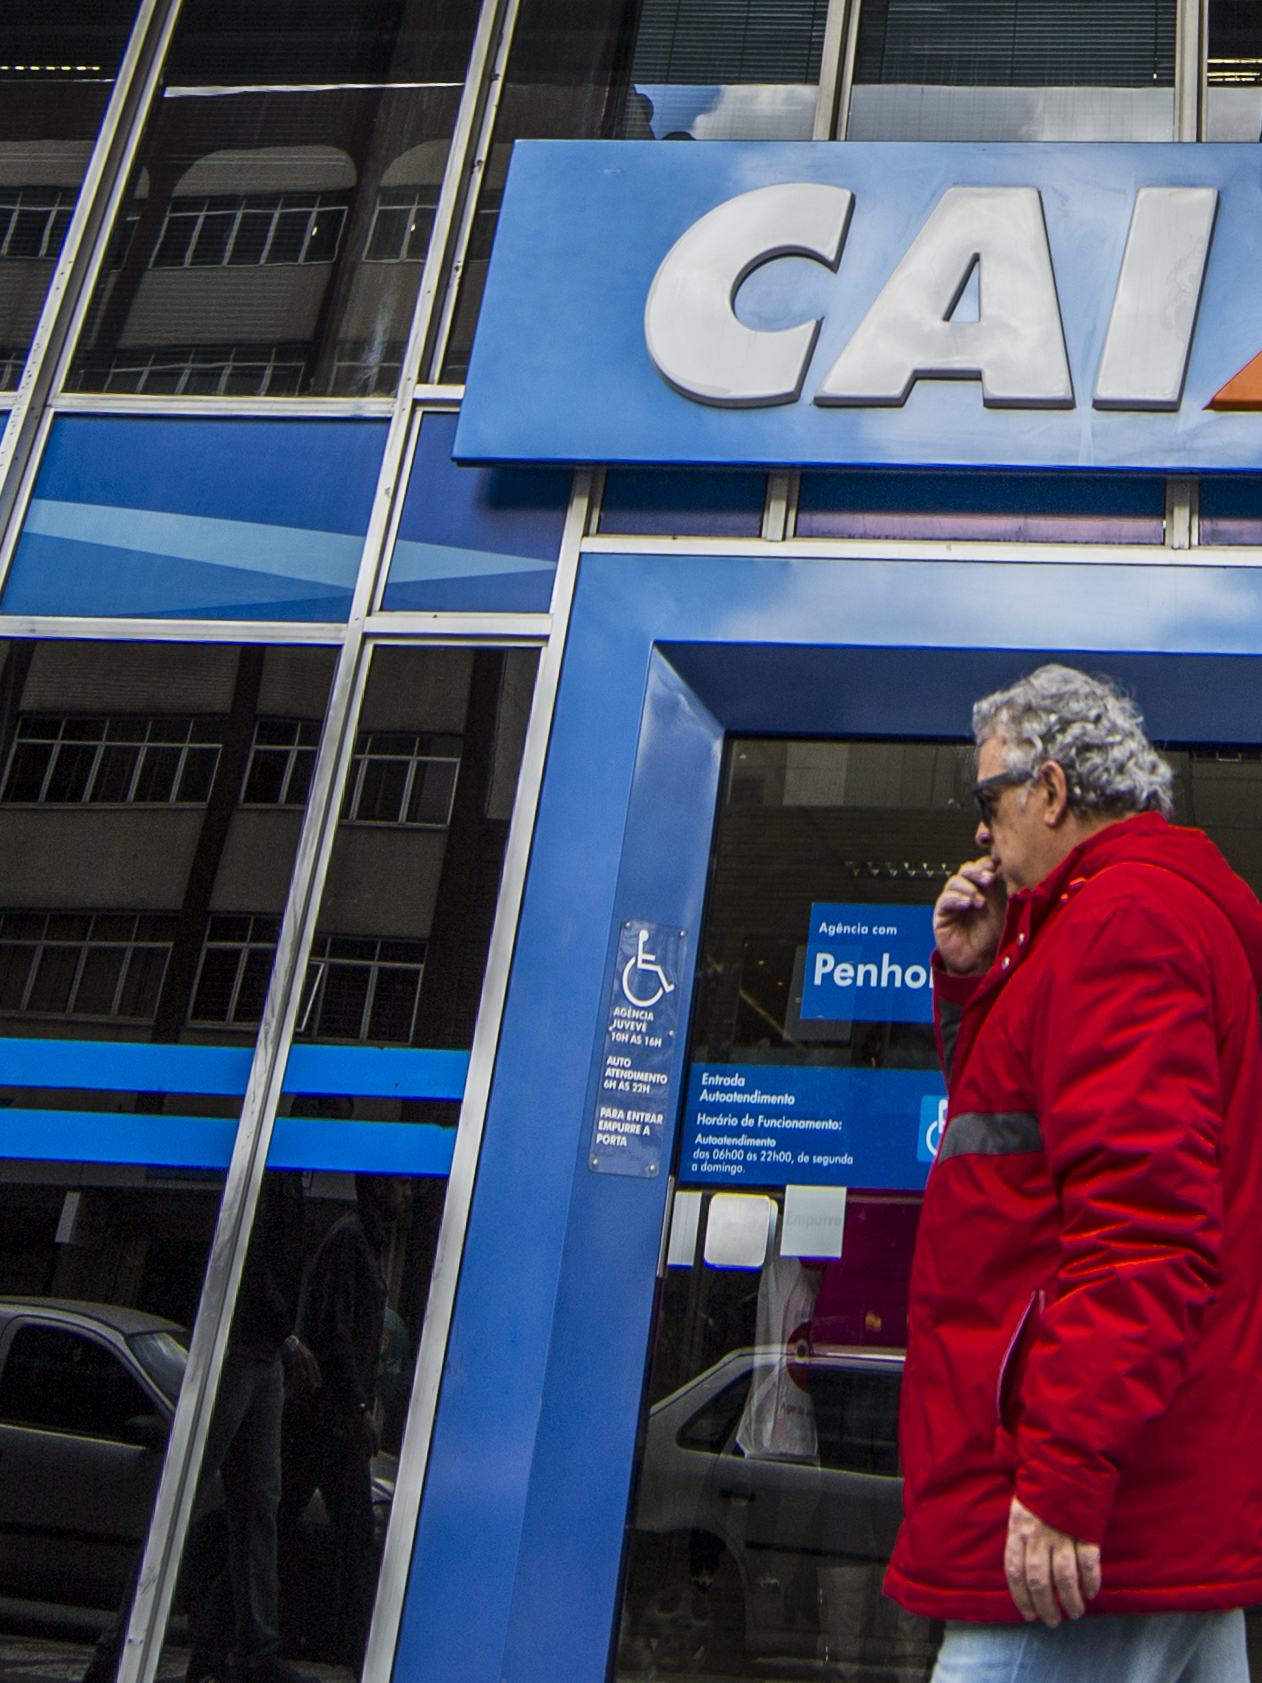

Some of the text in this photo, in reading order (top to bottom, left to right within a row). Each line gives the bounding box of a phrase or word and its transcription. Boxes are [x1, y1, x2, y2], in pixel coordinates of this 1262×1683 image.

[819, 921, 897, 936] Agência com
[611, 1032, 629, 1042] 10H
[645, 1036, 662, 1048] 16H
[606, 1055, 631, 1068] AUTO
[605, 1067, 668, 1085] ATENDIMENTO
[701, 1072, 745, 1087] Entrada
[603, 1079, 616, 1089] 6H
[632, 1082, 650, 1094] 22H
[699, 1089, 795, 1105] Autoatendimento
[600, 1107, 663, 1124] PARA ENTRAR
[697, 1113, 842, 1131] Horário de Funcionamento:
[598, 1120, 650, 1136] EMPURRE A
[596, 1133, 627, 1147] PORTA
[695, 1133, 776, 1147] Autoatendimento
[693, 1148, 710, 1159] das
[712, 1149, 744, 1161] 06h00
[760, 1151, 794, 1164] 22h00,
[798, 1152, 809, 1163] de
[812, 1153, 853, 1167] segunda
[691, 1162, 745, 1175] a domingo.
